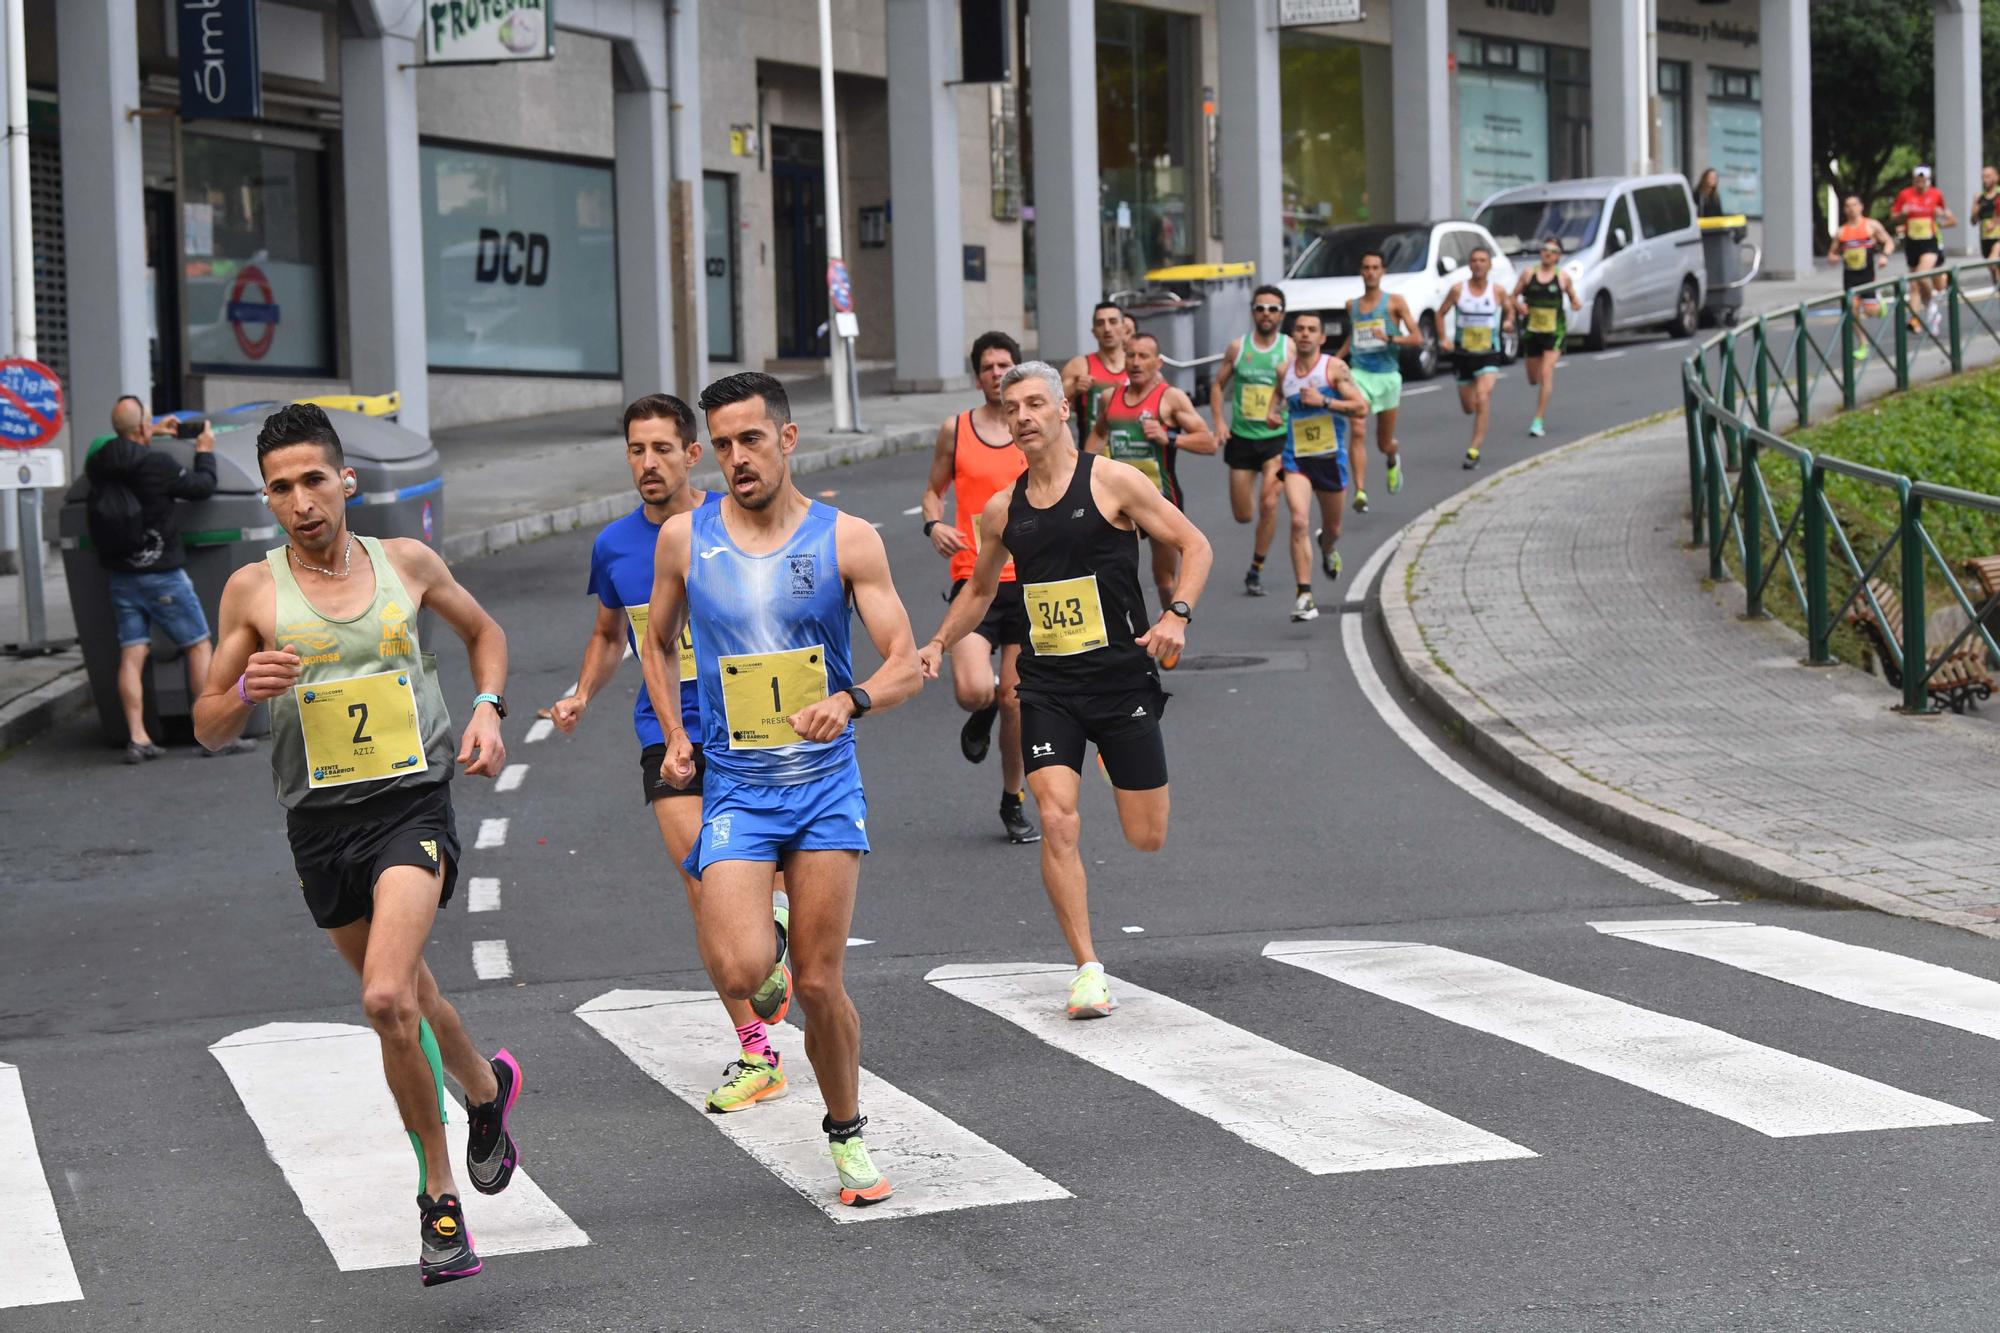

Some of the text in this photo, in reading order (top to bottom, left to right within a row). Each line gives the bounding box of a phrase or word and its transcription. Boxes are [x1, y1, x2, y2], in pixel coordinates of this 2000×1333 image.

[475, 228, 549, 287] DCD
[1038, 597, 1084, 630] 343
[771, 676, 782, 713] 1
[348, 702, 372, 744] 2
[353, 747, 375, 757] AZIZ
[328, 766, 355, 776] BARRIOS
